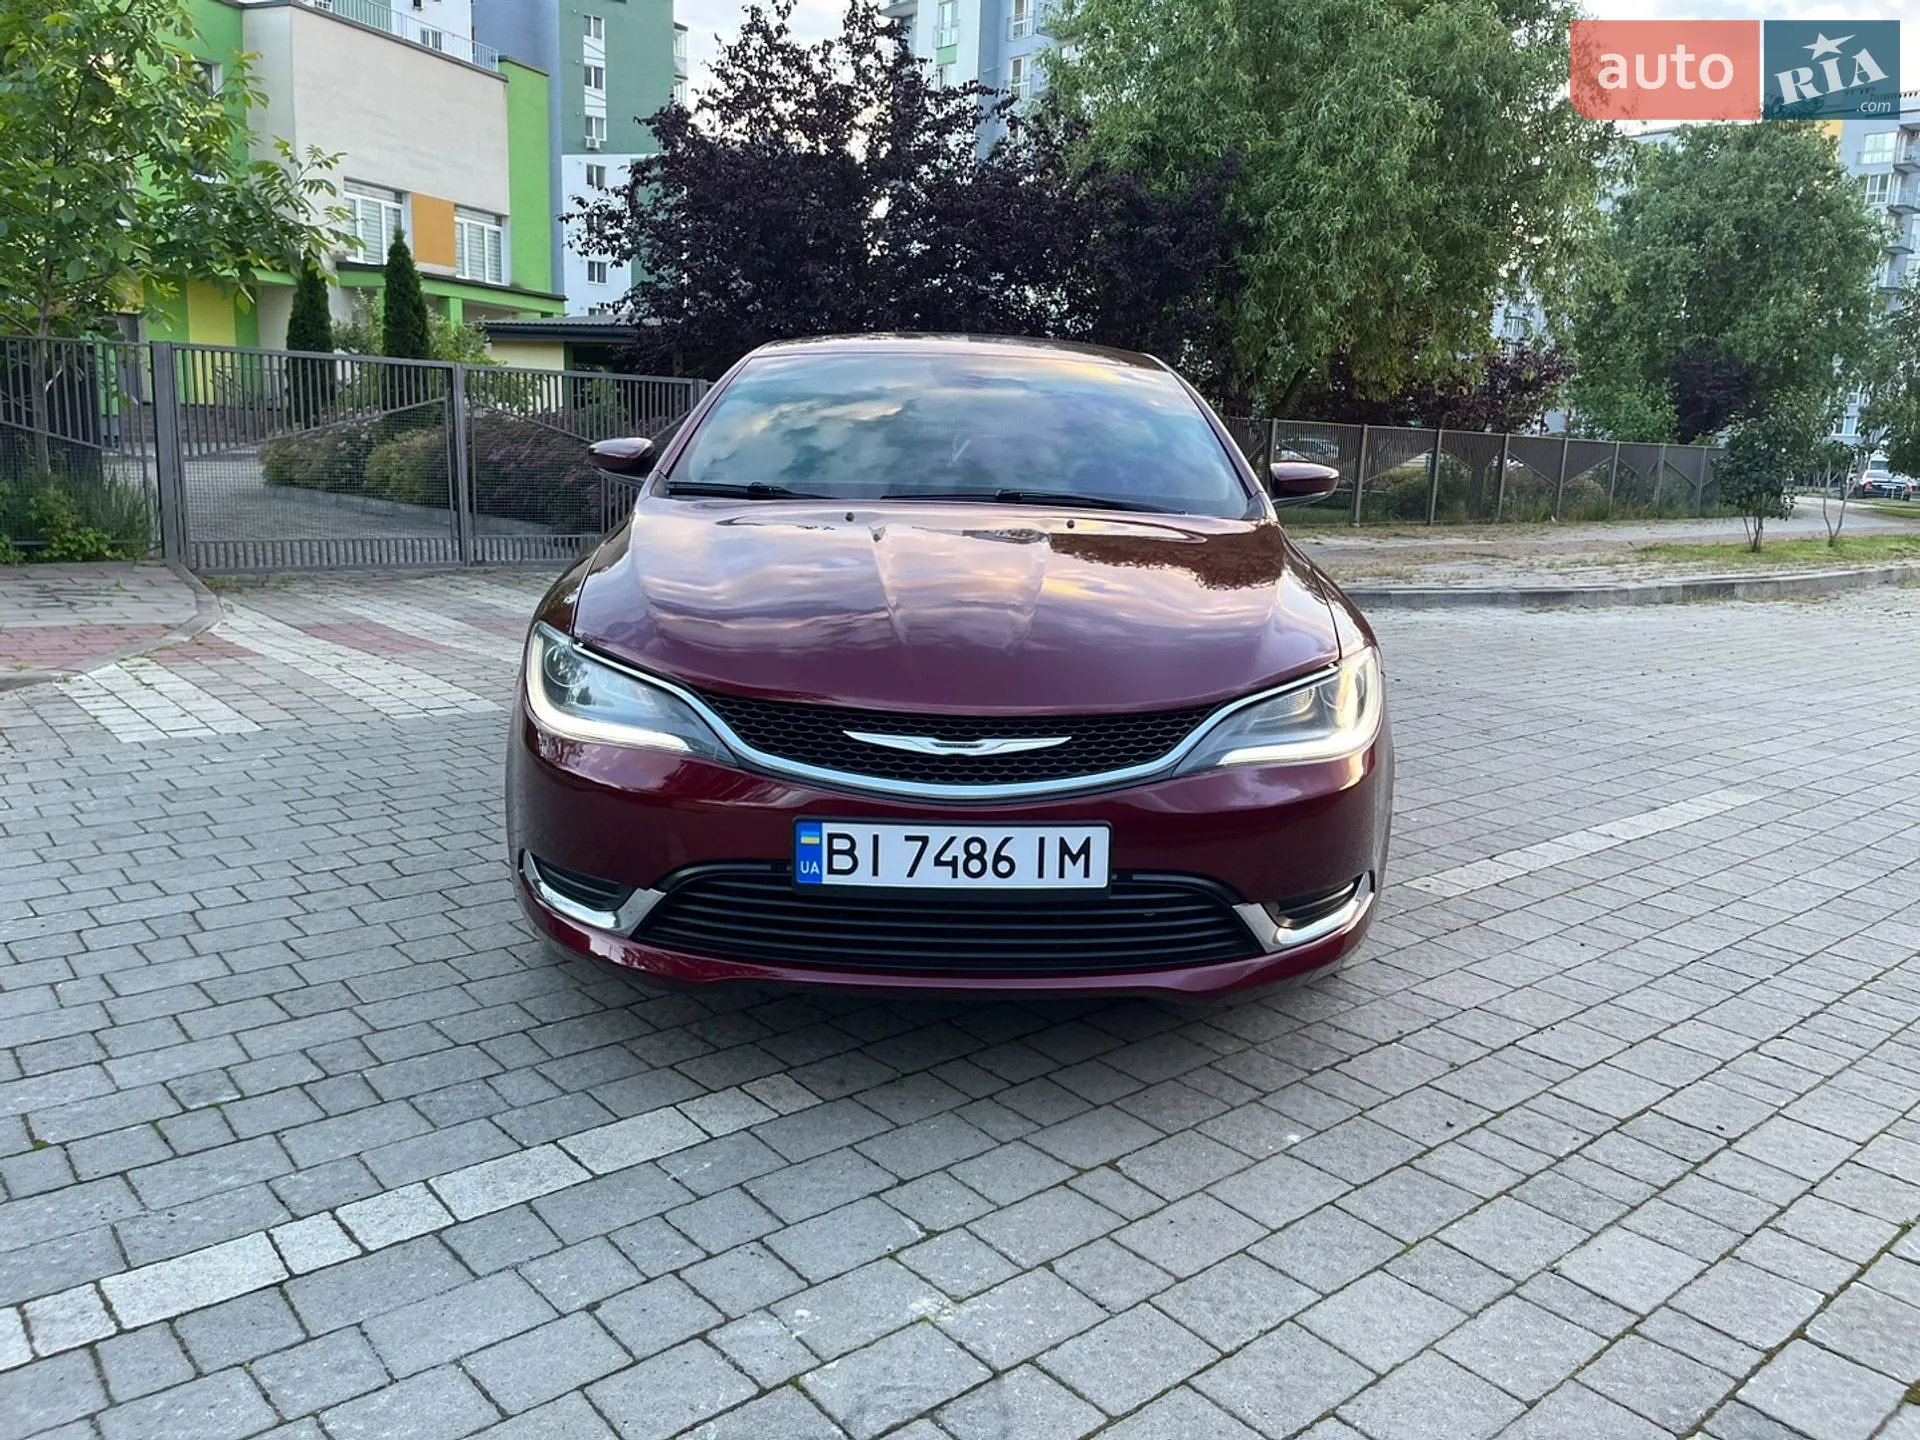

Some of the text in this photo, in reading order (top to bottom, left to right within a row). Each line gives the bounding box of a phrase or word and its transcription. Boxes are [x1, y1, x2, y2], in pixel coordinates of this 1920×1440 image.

[800, 860, 820, 875] UA
[826, 832, 1091, 879] BI 7486 IM
